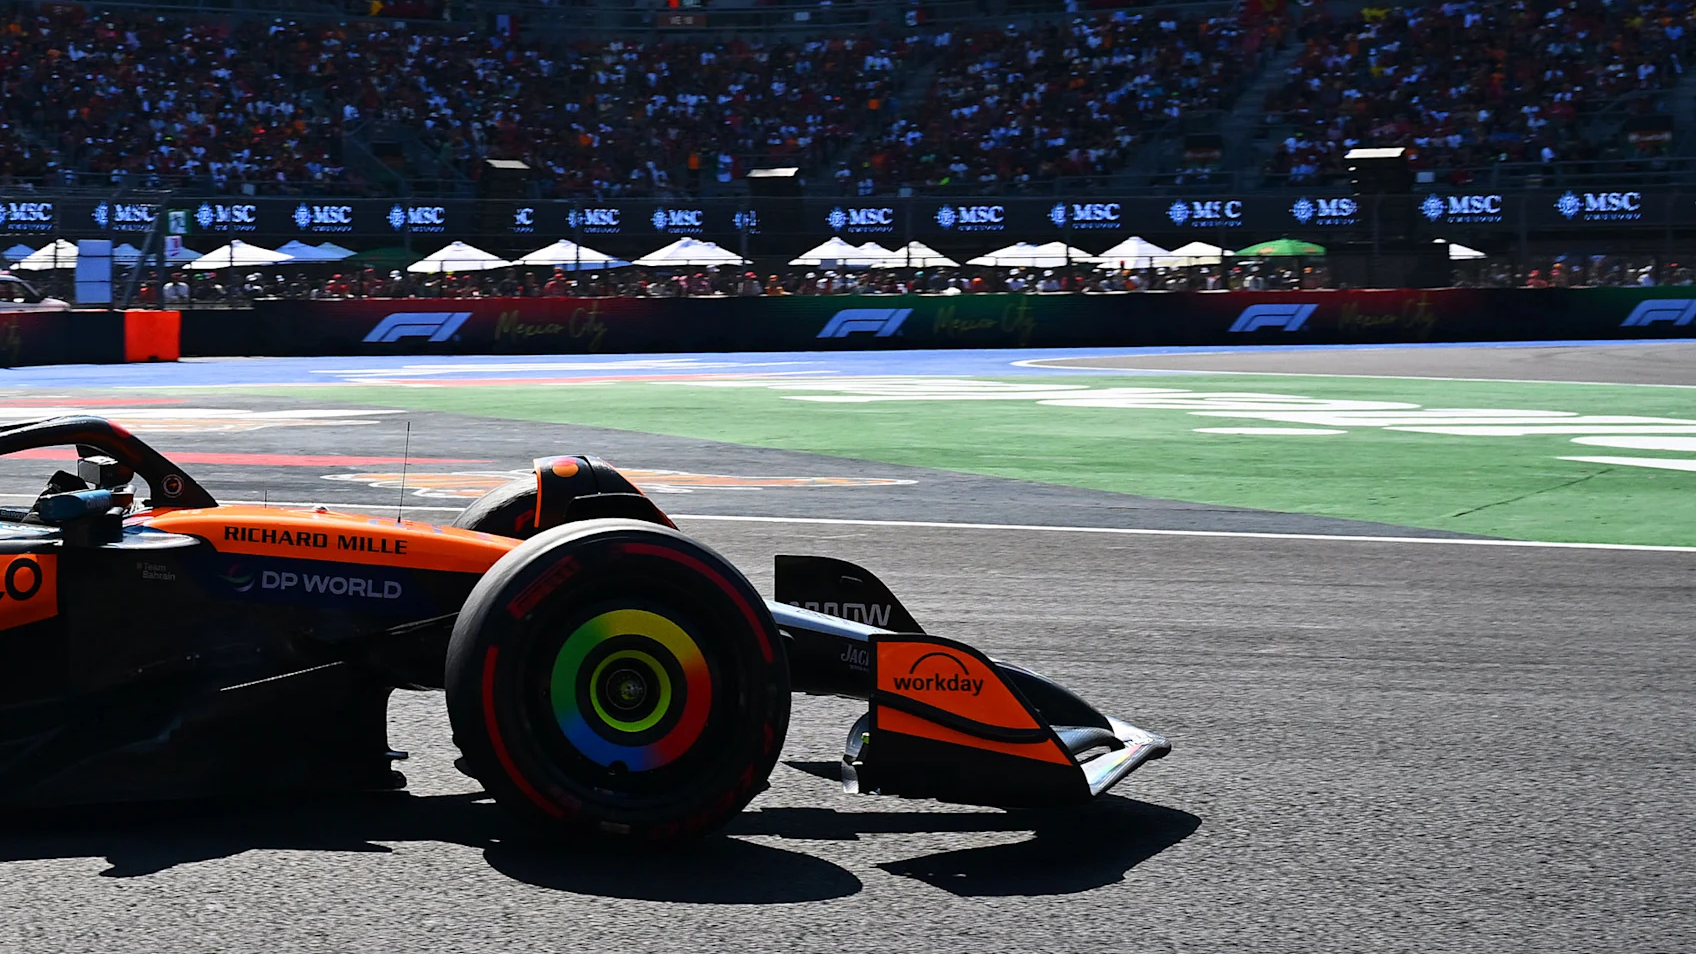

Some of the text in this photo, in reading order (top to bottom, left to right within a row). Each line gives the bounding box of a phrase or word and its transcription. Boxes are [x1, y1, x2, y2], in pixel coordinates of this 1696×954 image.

[1448, 195, 1501, 214] MSC
[1584, 192, 1640, 211] MSC
[8, 203, 52, 221] MSC
[312, 206, 351, 223] MSC
[408, 207, 444, 224] MSC
[583, 209, 619, 226] MSC
[668, 210, 702, 225] MSC
[846, 208, 892, 225] MSC
[959, 206, 1003, 223] MSC
[1073, 204, 1120, 220] MSC
[362, 311, 473, 342] F1
[816, 308, 914, 338] F1
[1228, 303, 1319, 333] F1
[224, 526, 408, 555] RICHARD MILLE
[142, 570, 176, 582] Bahrain
[262, 570, 403, 599] DP WORLD
[893, 673, 984, 696] workday
